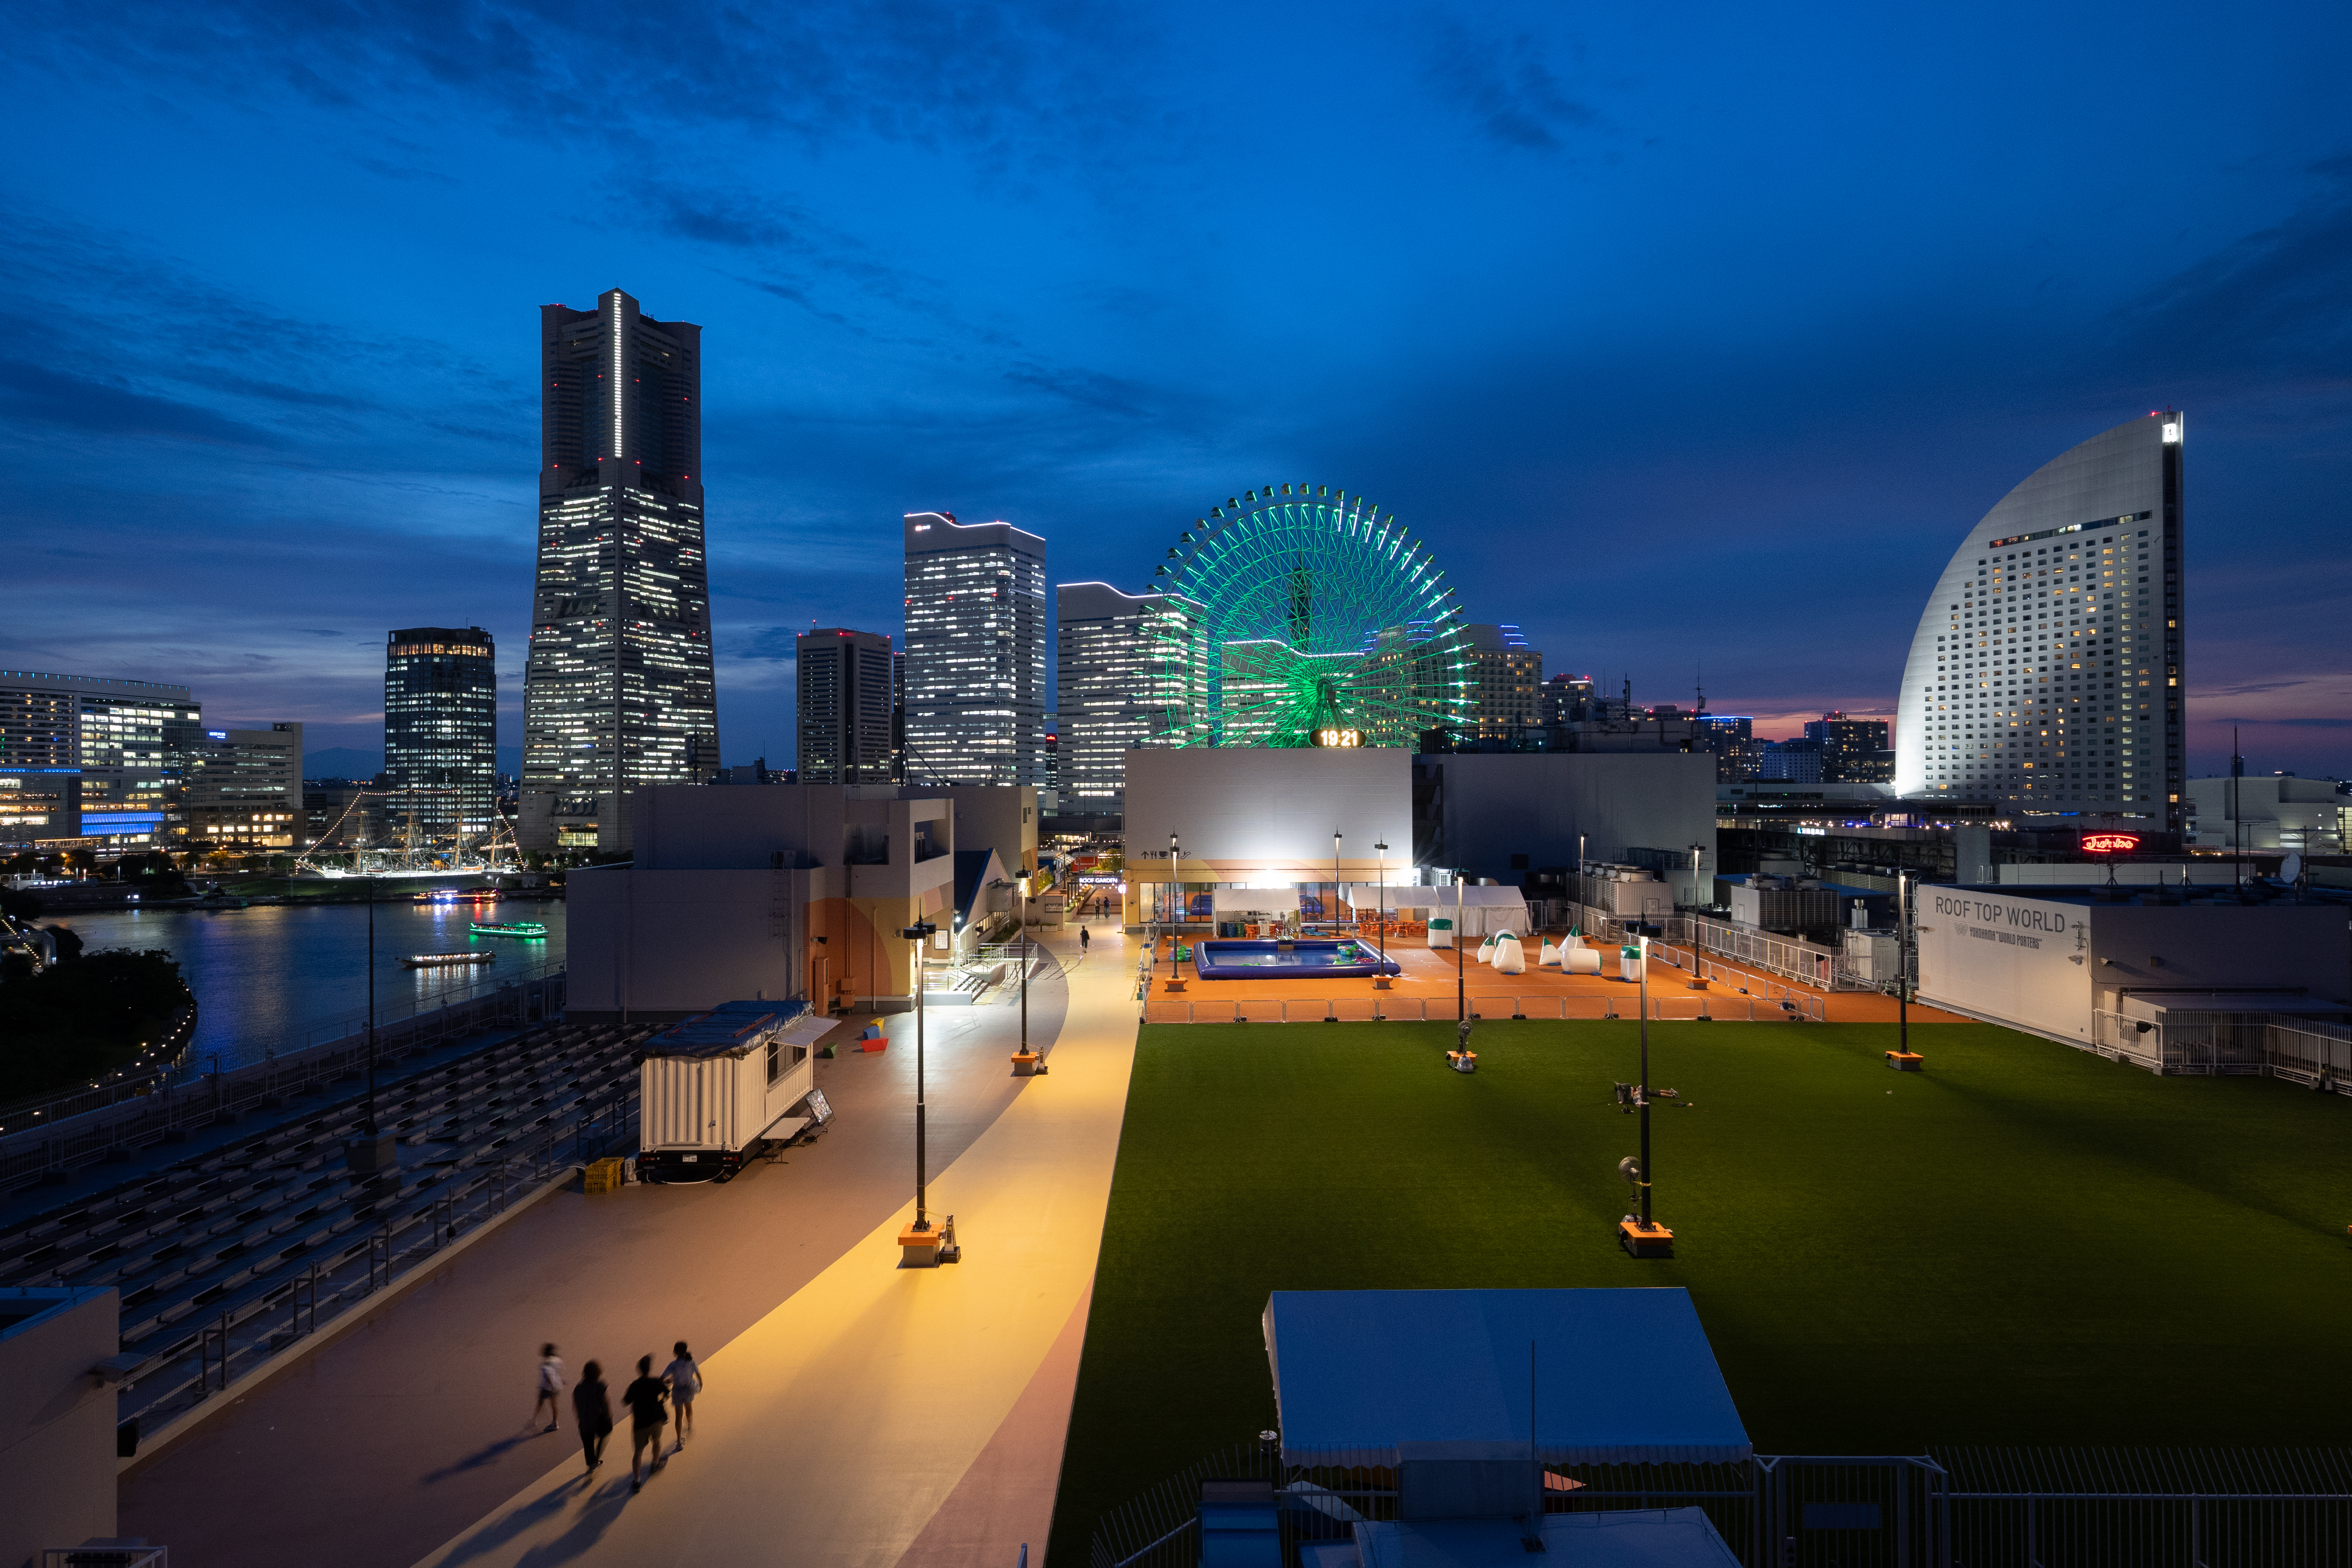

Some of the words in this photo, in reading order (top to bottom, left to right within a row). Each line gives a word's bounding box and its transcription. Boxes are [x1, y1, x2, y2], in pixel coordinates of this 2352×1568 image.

[1321, 730, 1357, 746] 19:21
[1936, 896, 1970, 918] ROOF
[1974, 902, 2002, 922] TOP
[2006, 906, 2065, 933] WORLD
[1969, 926, 1996, 941] YOKOHAMA
